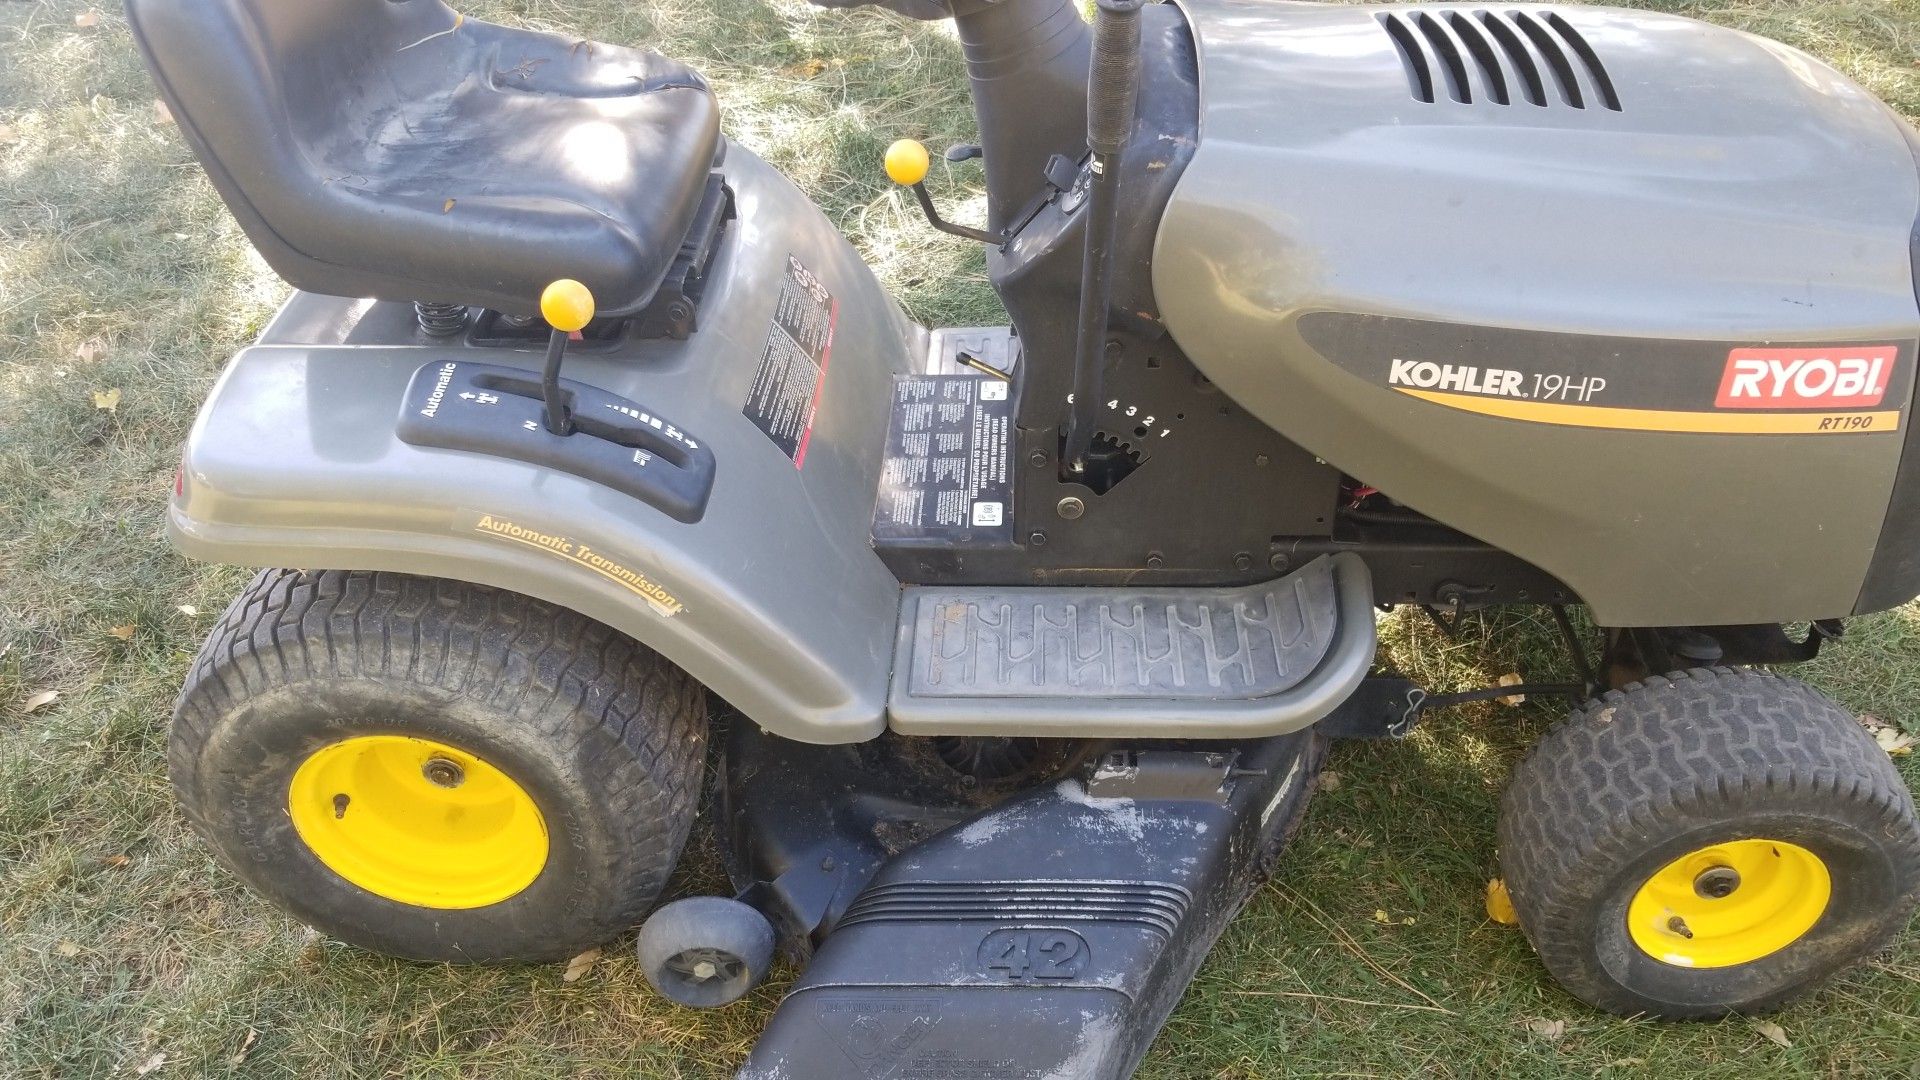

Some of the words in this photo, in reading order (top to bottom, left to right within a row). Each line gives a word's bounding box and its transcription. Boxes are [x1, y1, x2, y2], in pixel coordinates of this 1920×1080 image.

[420, 362, 456, 418] Automatic
[1389, 359, 1524, 397] KOHLER
[1534, 374, 1606, 402] 19HP
[1730, 358, 1884, 397] RYOBI
[523, 420, 538, 432] N
[976, 421, 982, 429] LE
[983, 413, 991, 450] INSTRUCTIONS
[1107, 399, 1118, 410] 4
[1125, 405, 1137, 417] 3
[1142, 415, 1155, 427] 2
[1160, 428, 1170, 438] 1
[1818, 416, 1873, 430] RT190
[974, 450, 980, 458] DU
[478, 515, 573, 553] Automatic
[575, 544, 677, 607] Transmission
[989, 932, 1079, 978] 42
